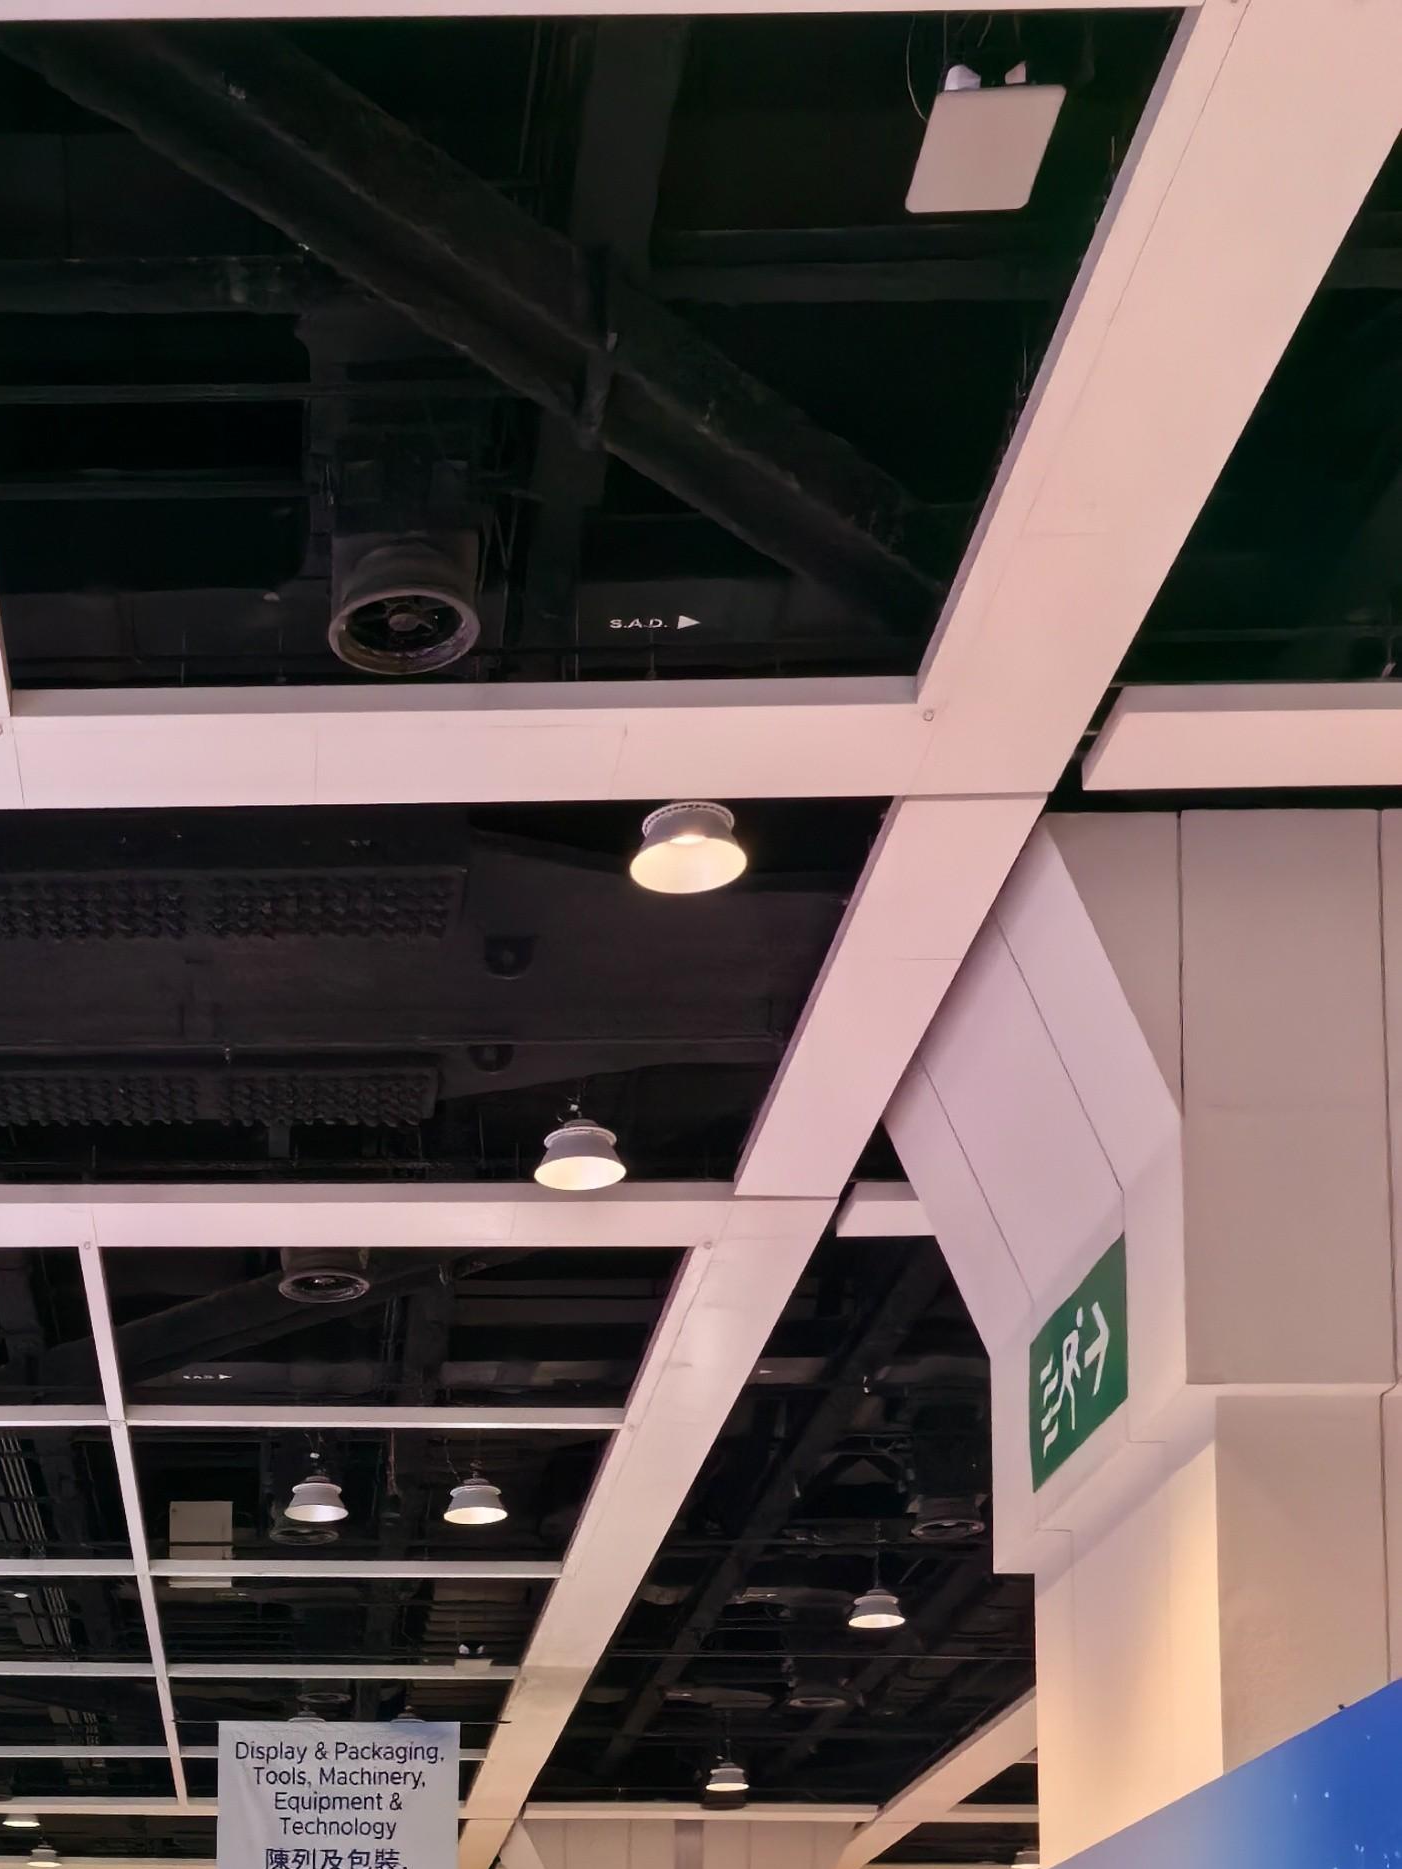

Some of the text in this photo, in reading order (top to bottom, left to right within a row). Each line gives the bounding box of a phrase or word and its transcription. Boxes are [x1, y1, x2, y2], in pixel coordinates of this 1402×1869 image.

[235, 1741, 307, 1764] Display
[314, 1742, 328, 1759] &
[253, 1766, 426, 1789] Tools, Machinery,
[274, 1792, 403, 1813] Equipment &
[279, 1817, 397, 1839] Technology
